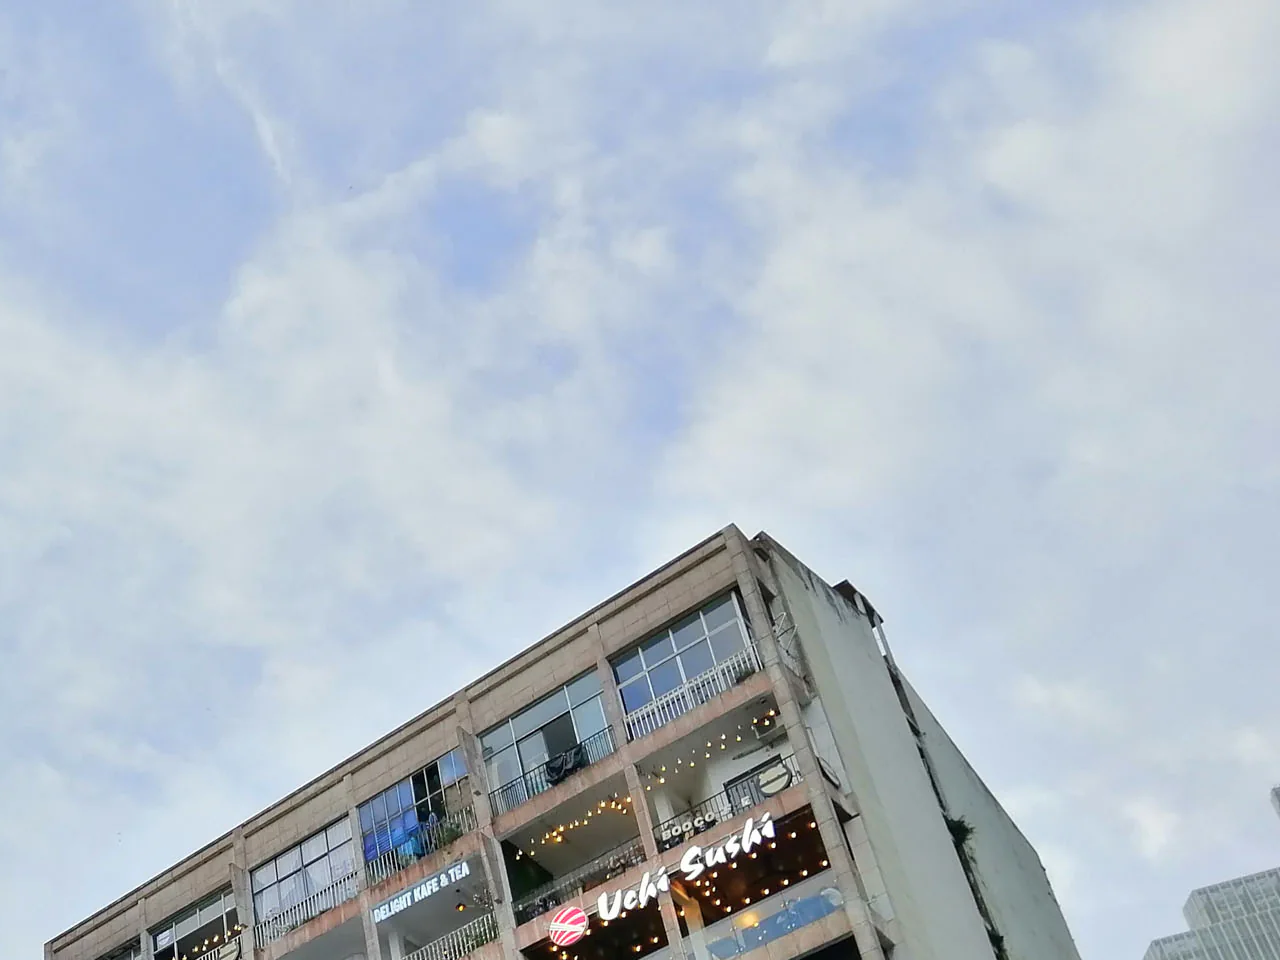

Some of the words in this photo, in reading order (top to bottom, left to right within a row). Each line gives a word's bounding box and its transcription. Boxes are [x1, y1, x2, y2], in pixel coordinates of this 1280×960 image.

[373, 891, 412, 923] DELIGHT
[413, 877, 440, 902] KAFE
[439, 873, 449, 887] &
[448, 861, 470, 882] TEA
[597, 866, 670, 921] Uchi
[680, 812, 776, 881] Sushi
